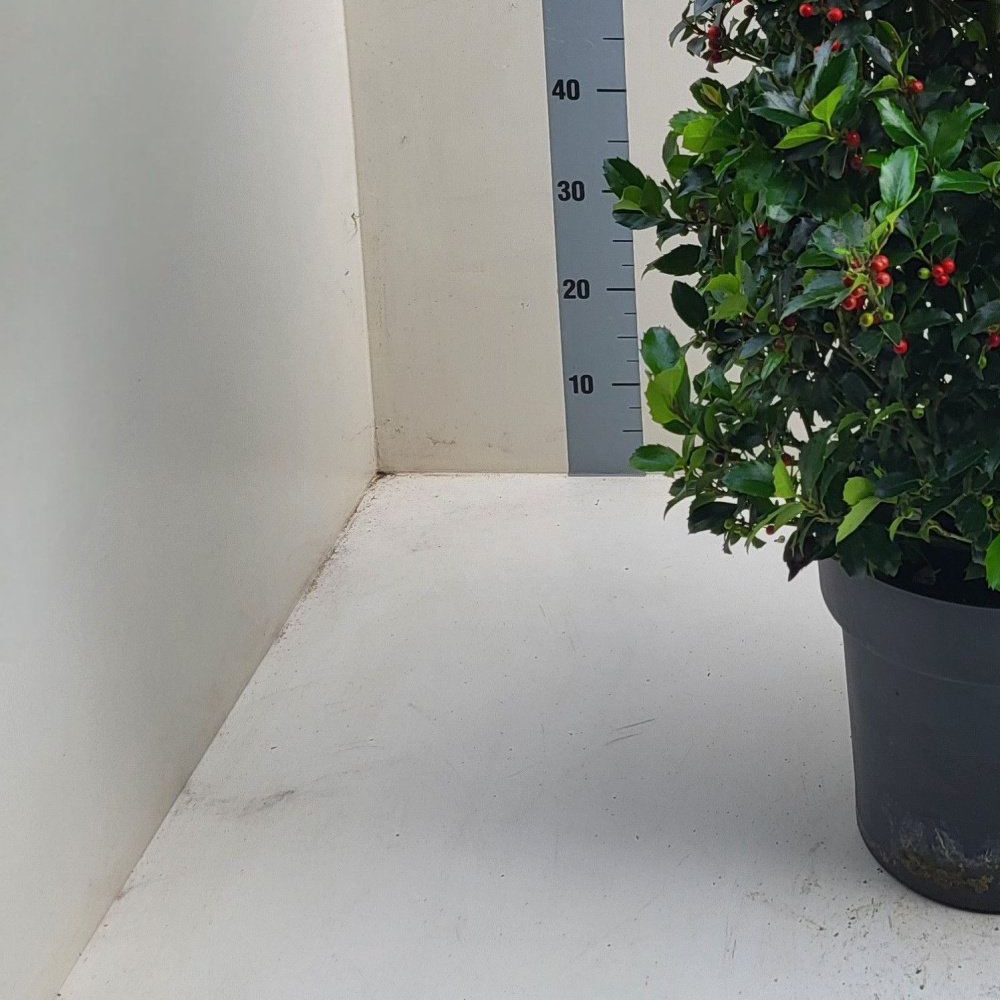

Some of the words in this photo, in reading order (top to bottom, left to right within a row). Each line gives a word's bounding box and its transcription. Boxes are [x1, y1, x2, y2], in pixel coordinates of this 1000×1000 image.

[551, 78, 580, 101] 40
[557, 180, 585, 202] 30
[562, 278, 590, 300] 20
[568, 374, 594, 395] 10
